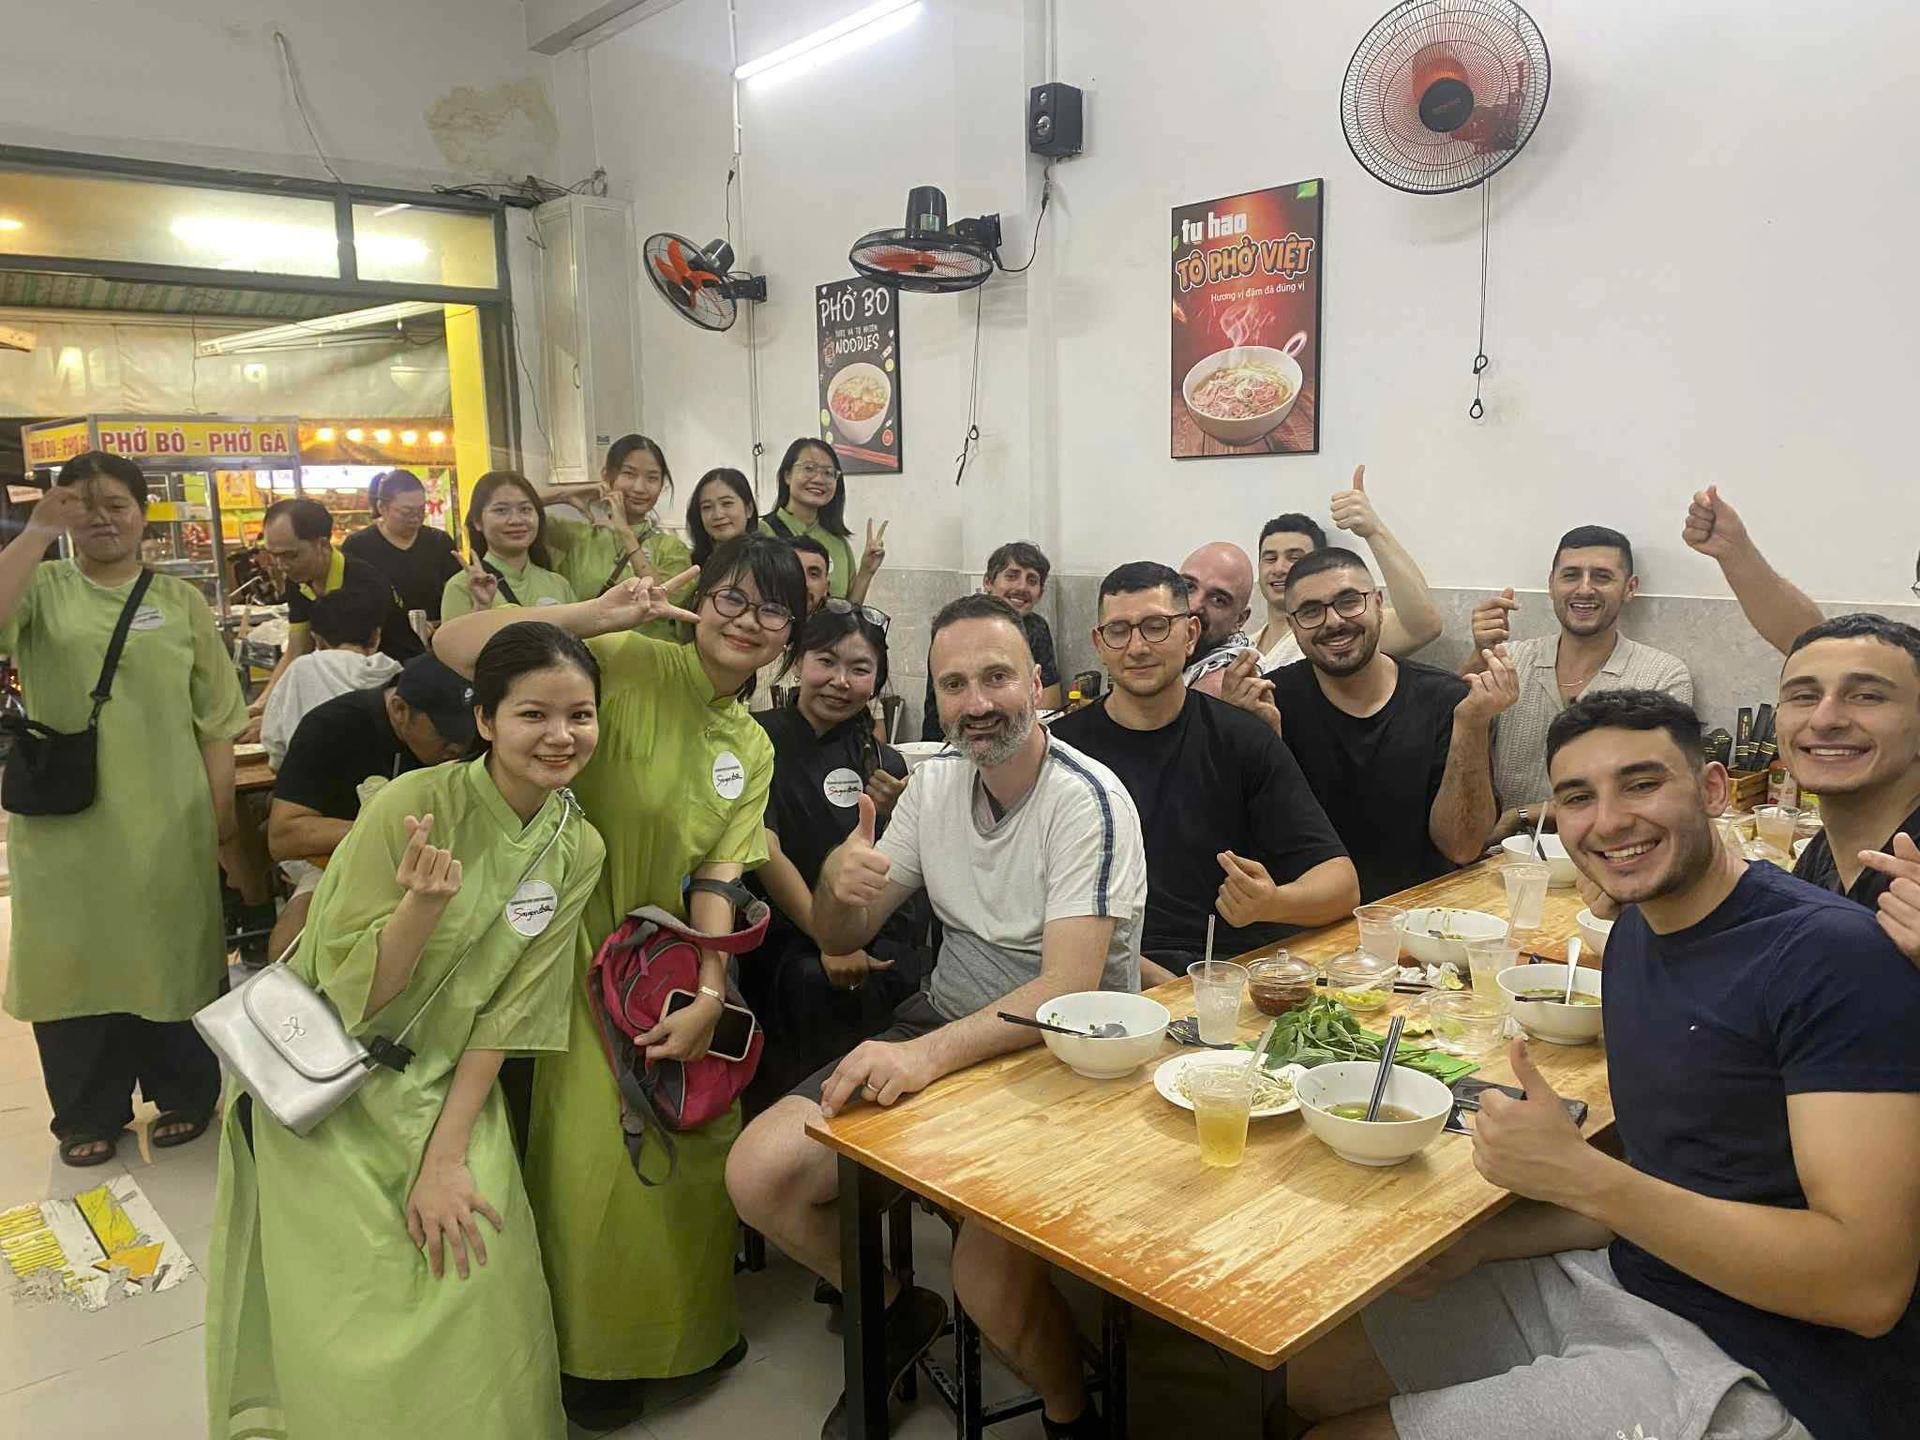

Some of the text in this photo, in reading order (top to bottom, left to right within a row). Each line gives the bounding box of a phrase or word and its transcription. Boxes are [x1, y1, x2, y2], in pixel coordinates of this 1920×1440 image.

[1176, 232, 1316, 292] TÔ PHỞ VIỆT
[835, 333, 880, 354] NOODLES
[100, 425, 148, 452] PHỞ
[155, 427, 185, 452] BÒ
[208, 426, 252, 453] PHỞ
[259, 429, 287, 453] GÀ
